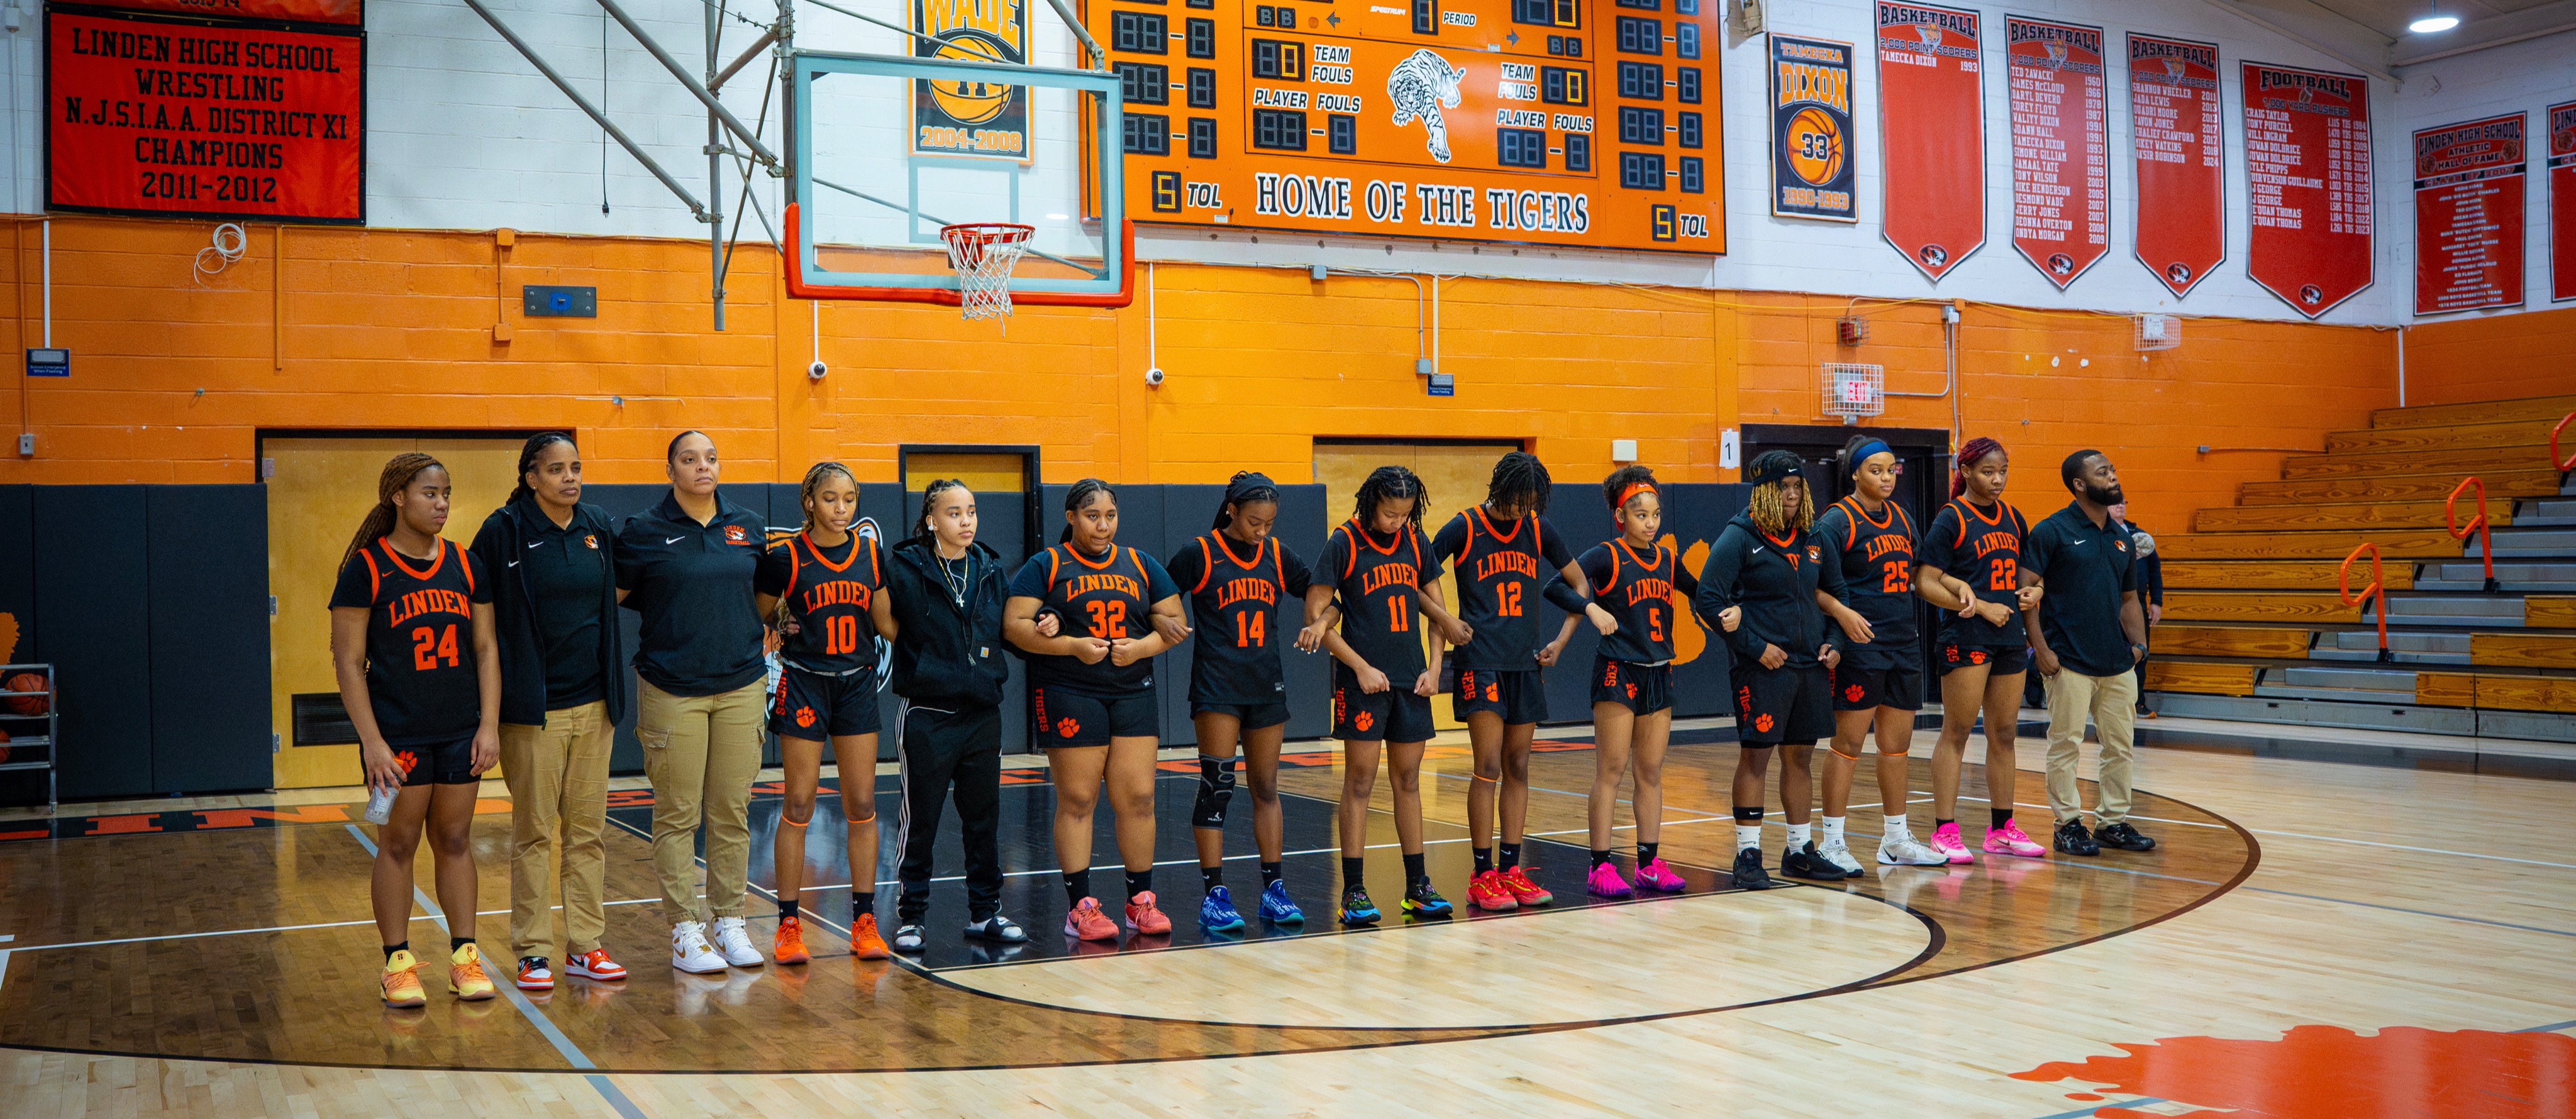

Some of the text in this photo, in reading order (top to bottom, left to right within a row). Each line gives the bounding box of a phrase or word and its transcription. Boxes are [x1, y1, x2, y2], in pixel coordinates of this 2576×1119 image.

[1370, 6, 1406, 16] SPECTRUM
[1443, 11, 1476, 26] PERIOD
[1880, 5, 1976, 40] BASKETBALL
[72, 28, 340, 73] LINDEN HIGH SCHOOL
[1880, 38, 1977, 59] 2,000 POINT SCORERS
[2010, 22, 2099, 55] BASKETBALL
[1314, 45, 1352, 65] TEAM
[1780, 42, 1844, 64] TAMECKA
[1881, 50, 1977, 72] TAMECKA DIXON 1993
[2131, 40, 2215, 70] BASKETBALL
[1311, 65, 1353, 85] FOULS
[1501, 62, 1535, 82] TEAM
[2011, 67, 2023, 77] TED
[2085, 76, 2101, 87] 1960
[2036, 58, 2060, 69] POINT
[2063, 61, 2101, 74] SCORERS
[135, 68, 284, 102] WRESTLING
[1498, 80, 1537, 101] FOULS
[1777, 62, 1850, 117] DIXON
[2012, 78, 2033, 90] JAMES
[2085, 87, 2101, 98] 1966
[2133, 82, 2216, 101] SHANNON WHEELER 2011
[2180, 77, 2216, 89] SCORERS
[2260, 69, 2350, 101] FOOTBALL
[1253, 88, 1362, 114] PLAYER FOULS
[2012, 89, 2034, 101] DARYL
[2085, 99, 2101, 109] 1978
[2012, 101, 2102, 121] COREY FLOYD 1987
[2134, 94, 2217, 112] JADA LEWIS 2013
[2312, 104, 2349, 117] RUSHERS
[65, 96, 347, 140] N.J.S.I.A.A. DISTRICT XI
[1497, 109, 1594, 133] PLAYER FOULS
[2040, 116, 2059, 127] DIXON
[2086, 121, 2102, 131] 1991
[2155, 119, 2174, 129] JONES
[2202, 124, 2218, 134] 2017
[2158, 107, 2217, 123] MOORE 2013
[2246, 108, 2289, 121] CRAIG TAYLOR
[2247, 119, 2293, 133] TONY PURCELL
[920, 126, 1022, 153] 2004-2008
[2014, 124, 2102, 143] JOANN HALL 1991
[2014, 136, 2103, 154] TAMECKA DIXON 1993
[2162, 130, 2194, 143] CRAWFORD
[2203, 135, 2218, 145] 2017
[2418, 121, 2521, 156] LINDEN HIGH SCHOOL
[135, 136, 283, 169] CHAMPIONS
[1801, 132, 1829, 160] 33
[2014, 147, 2103, 165] SIMONE GILLIAM 1993
[2155, 140, 2218, 156] WATKINS 2018
[2448, 141, 2490, 157] ATHLETIC
[2015, 158, 2103, 177] JAMAAL TATE 1999
[2155, 152, 2219, 167] ROBINSON 2024
[2438, 152, 2501, 170] HALL OF FAME
[142, 172, 276, 202] 2011-2012
[2424, 175, 2462, 187] CLASS
[2484, 167, 2515, 178] 2007
[1157, 175, 1176, 209] 5
[1186, 182, 1223, 209] TOL
[1783, 186, 1850, 211] 1990-1993
[2015, 181, 2104, 199] MIKE HENDERSON 2005
[2016, 193, 2104, 210] DESMOND WADE 2007
[1255, 173, 1590, 234] HOME OF THE TIGERS
[1655, 206, 1673, 239] 5
[1679, 213, 1709, 238] TOL
[2043, 219, 2072, 231] OVERTON
[2089, 223, 2104, 233] 2008
[2039, 229, 2065, 241] MORGAN
[2089, 234, 2104, 245] 2009
[1848, 382, 1867, 402] EXIT
[1725, 443, 1731, 460] 1
[1865, 535, 1913, 562] LINDEN
[1974, 532, 2019, 560] LINDEN
[1477, 551, 1536, 582] LINDEN
[1883, 561, 1909, 593] 25
[1990, 559, 2016, 591] 22
[1066, 573, 1140, 602] LINDEN
[1362, 563, 1418, 596] LINDEN
[803, 581, 871, 615] LINDEN
[1217, 577, 1275, 610] LINDEN
[1496, 582, 1523, 617] 12
[1626, 578, 1674, 608] LINDEN
[389, 588, 470, 628] LINDEN
[1085, 600, 1126, 639] 32
[1387, 595, 1408, 632] 11
[826, 615, 856, 654] 10
[1236, 610, 1265, 647] 14
[1649, 608, 1663, 642] 5
[412, 624, 458, 671] 24
[1036, 687, 1049, 732] TIGERS
